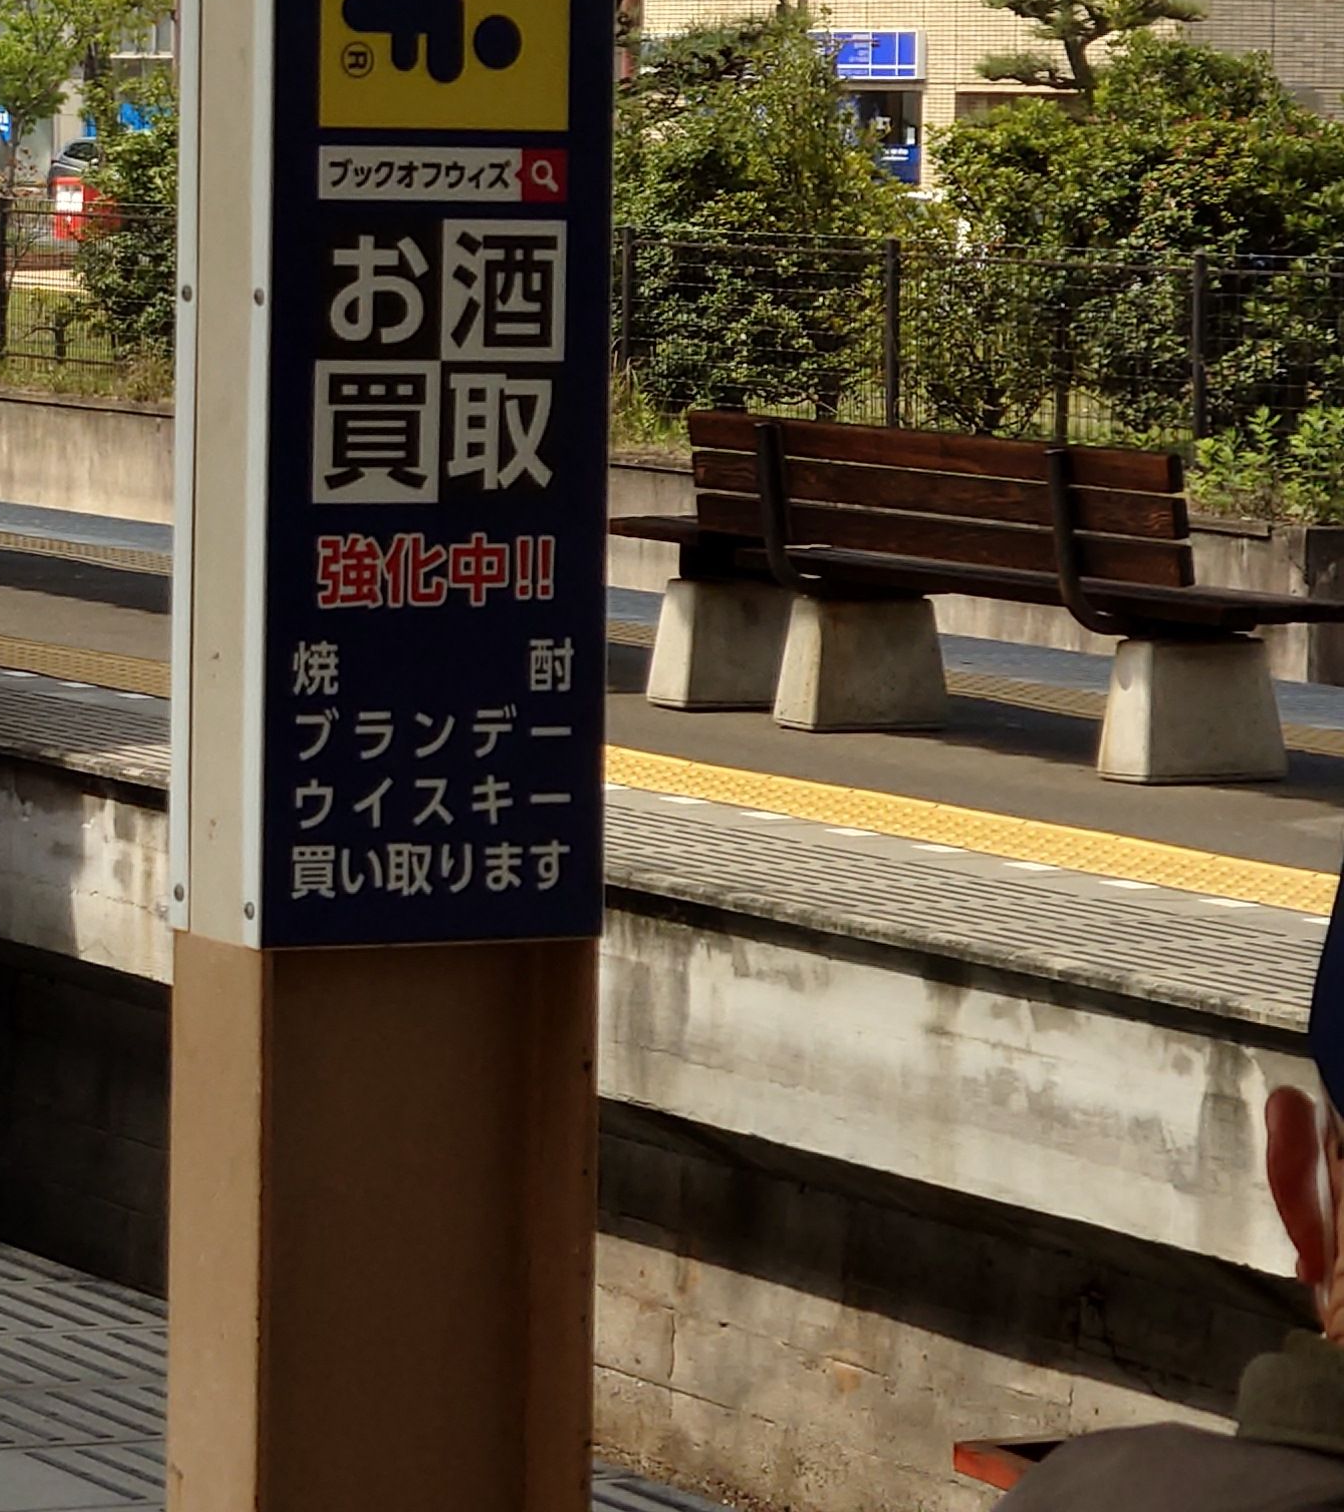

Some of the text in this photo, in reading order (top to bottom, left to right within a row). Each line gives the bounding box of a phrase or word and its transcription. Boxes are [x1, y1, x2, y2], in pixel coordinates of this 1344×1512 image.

[328, 157, 512, 190] ブックオフウィズ
[329, 230, 559, 349] お酒
[323, 372, 554, 491] 買取
[295, 703, 573, 761] ブランデー
[295, 774, 572, 830] ウイスキー
[291, 839, 571, 900] 買い取ります
